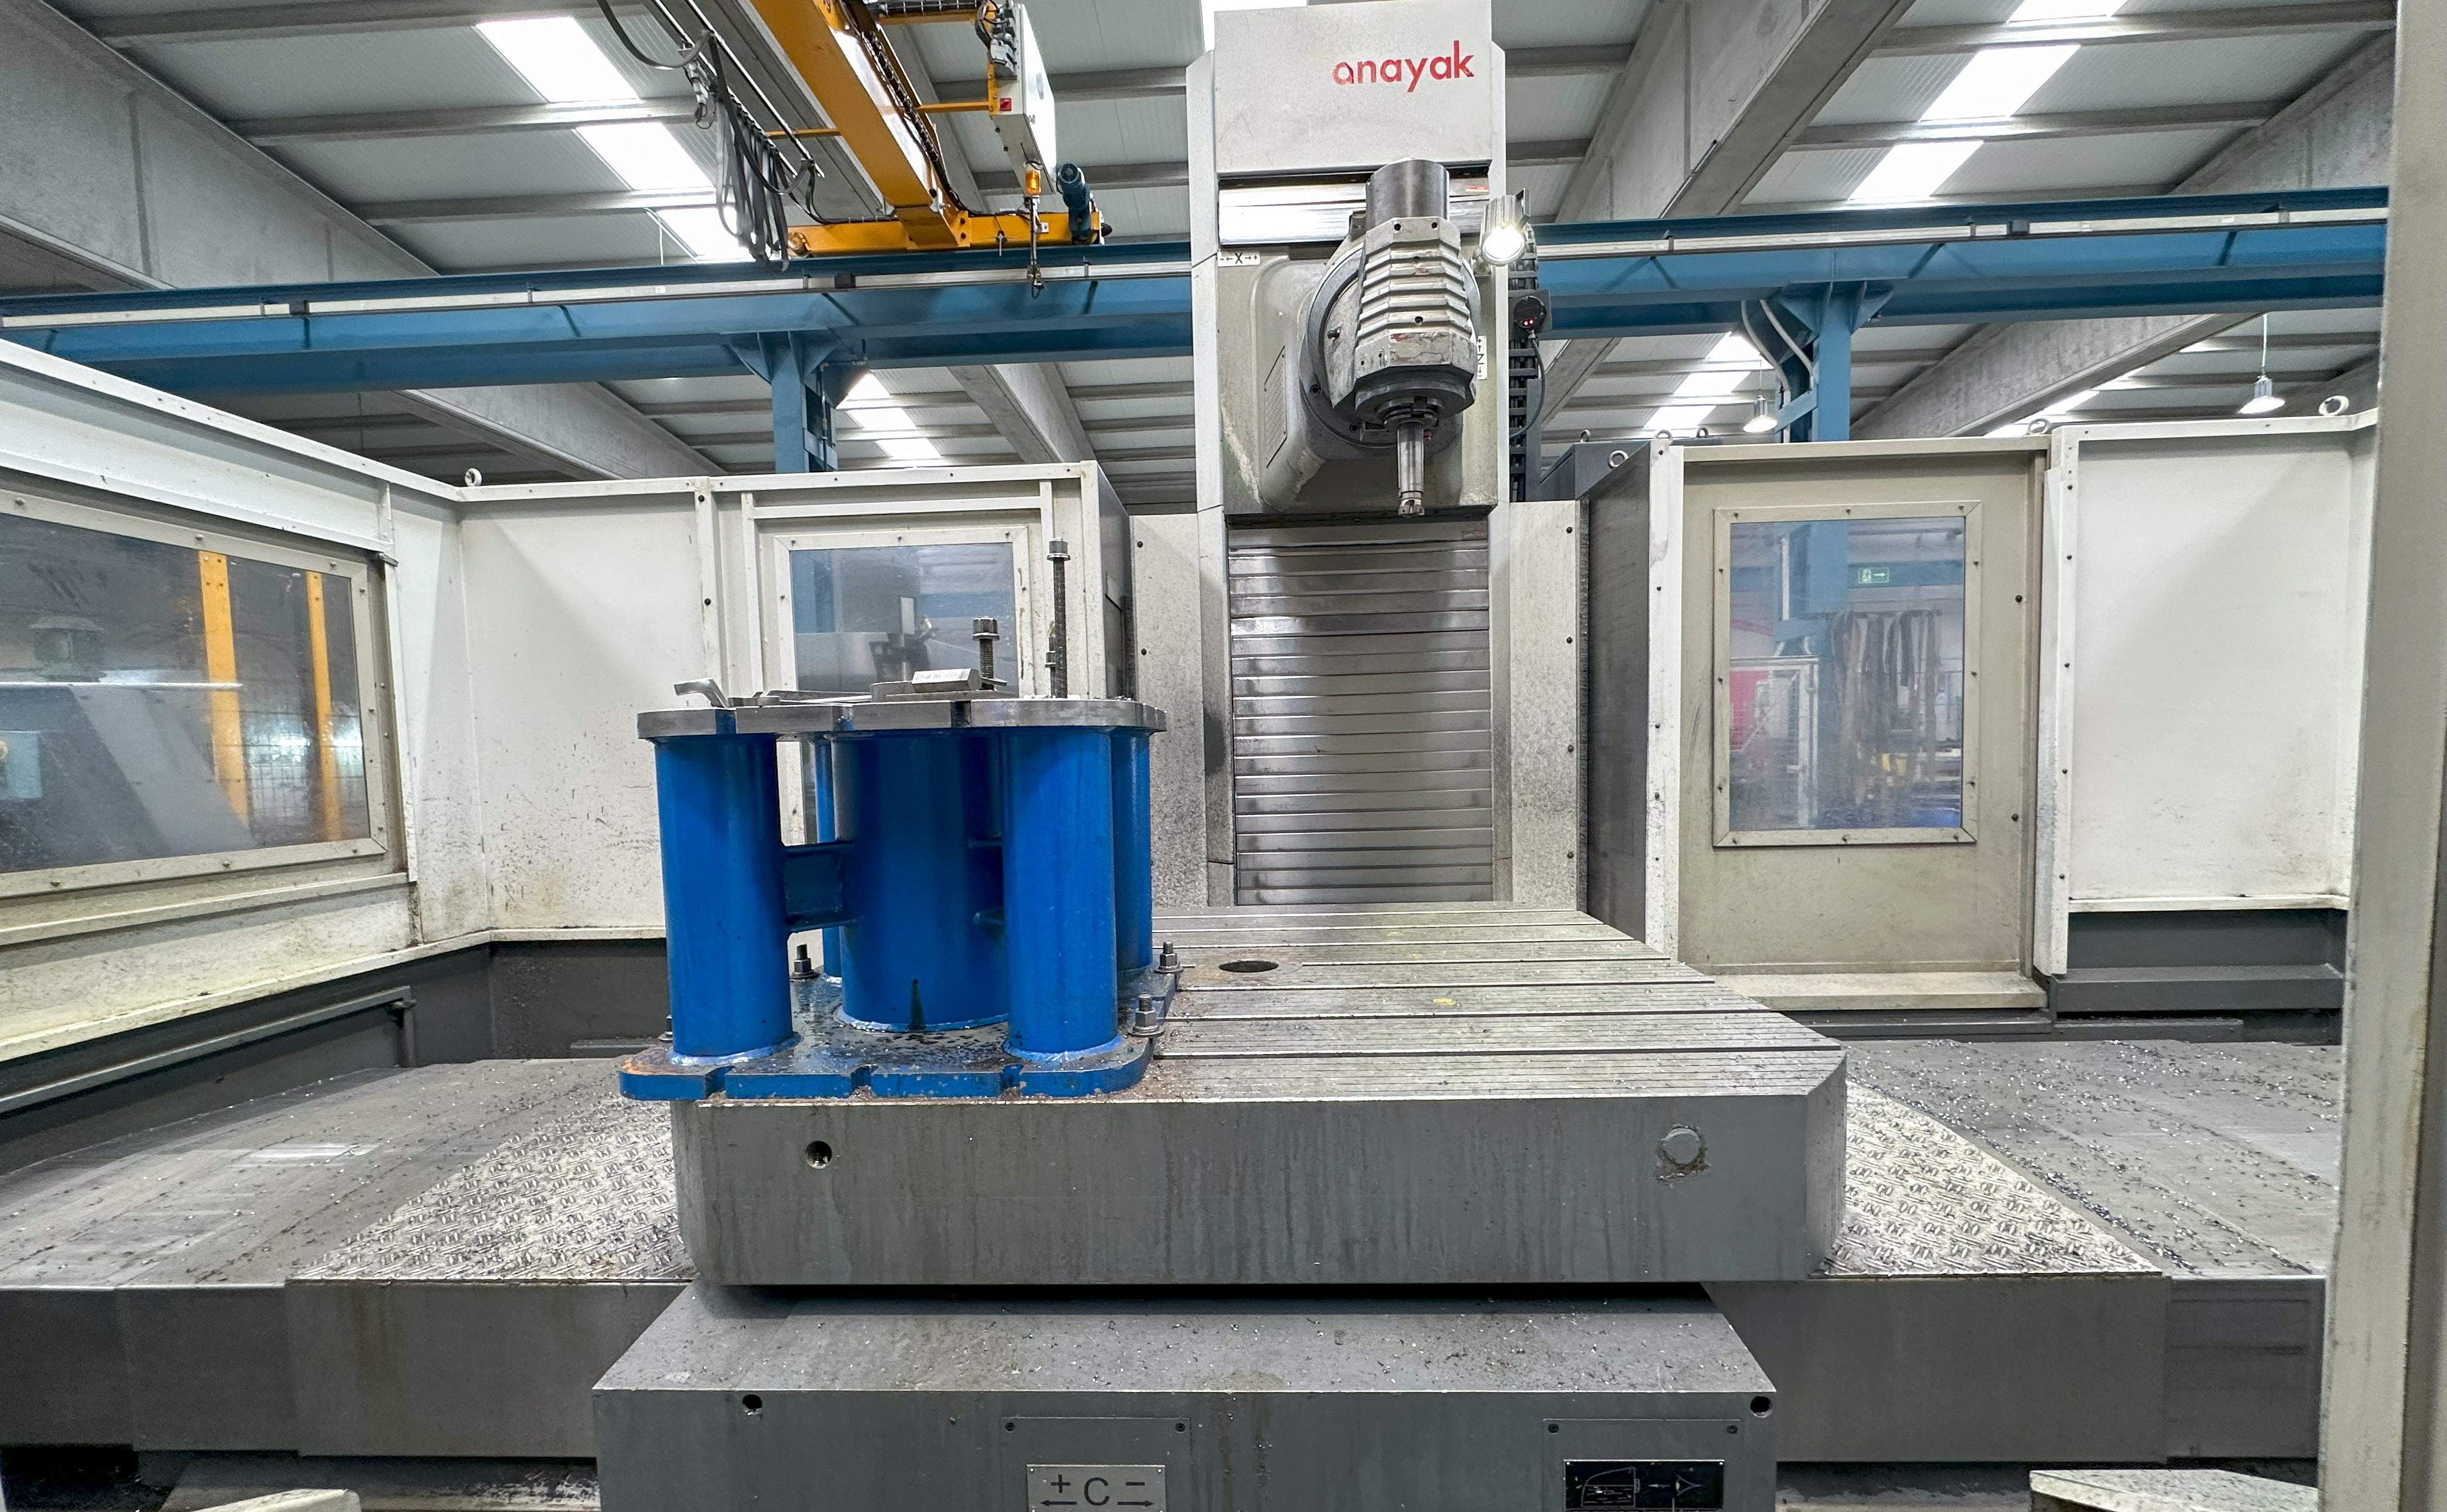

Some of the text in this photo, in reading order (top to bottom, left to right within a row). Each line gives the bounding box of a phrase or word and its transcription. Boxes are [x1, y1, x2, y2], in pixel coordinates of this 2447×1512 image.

[1332, 40, 1474, 93] anayak
[1234, 252, 1244, 265] X
[1084, 1477, 1110, 1506] C
